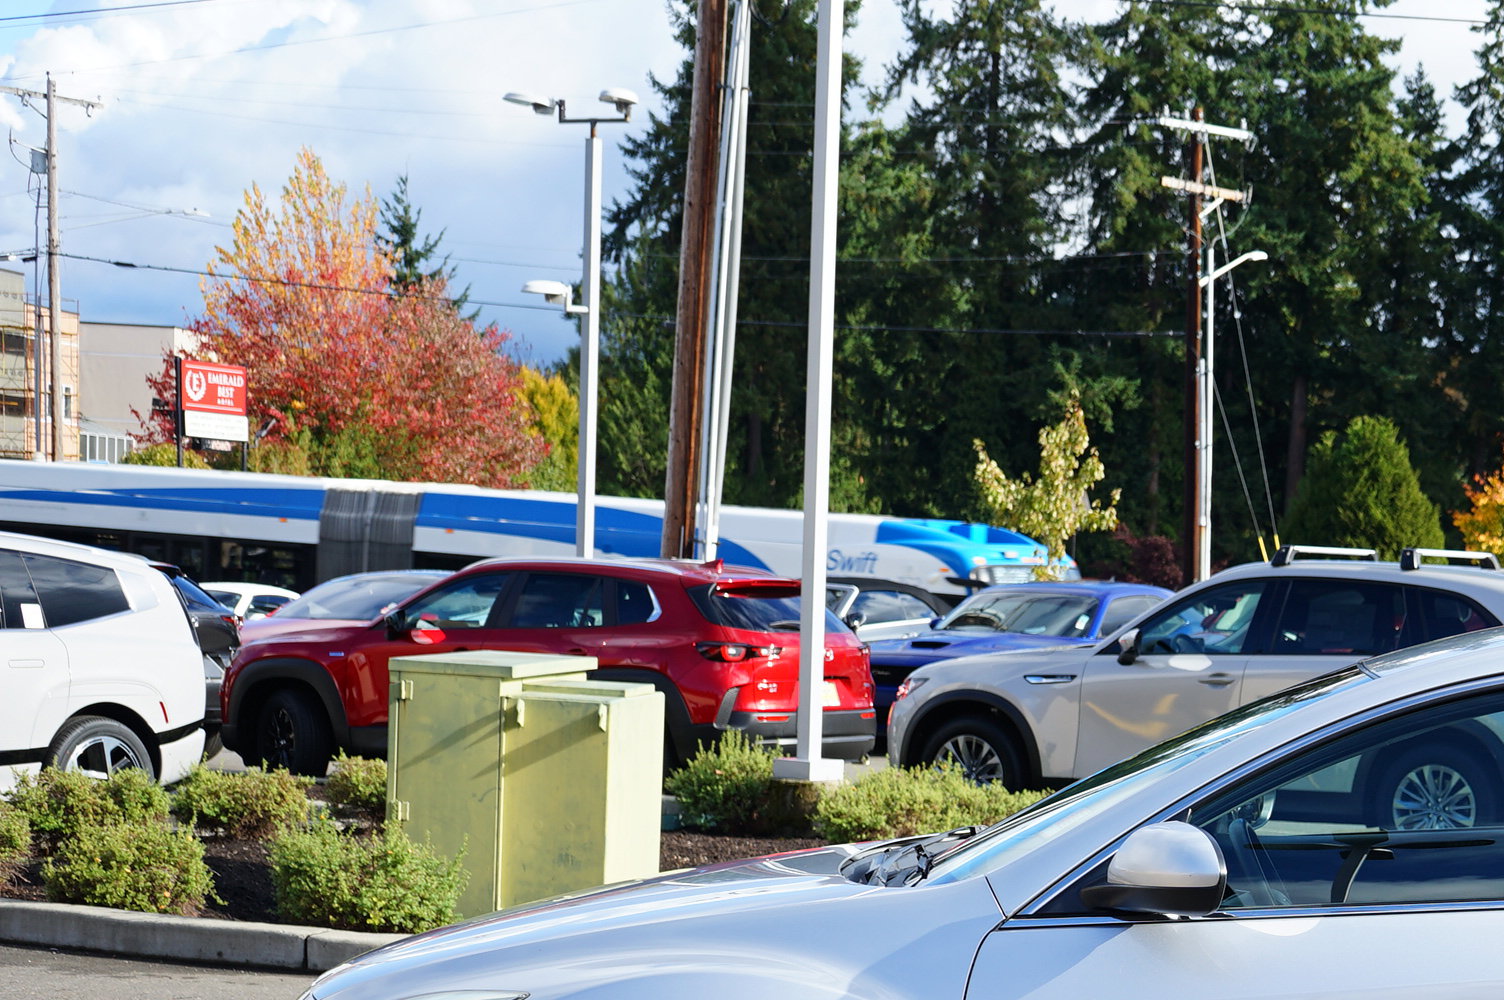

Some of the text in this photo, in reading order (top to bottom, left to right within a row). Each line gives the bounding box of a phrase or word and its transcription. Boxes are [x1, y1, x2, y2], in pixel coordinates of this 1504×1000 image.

[207, 372, 244, 388] EMERALD
[217, 385, 235, 398] BEST
[826, 549, 880, 574] Swift
